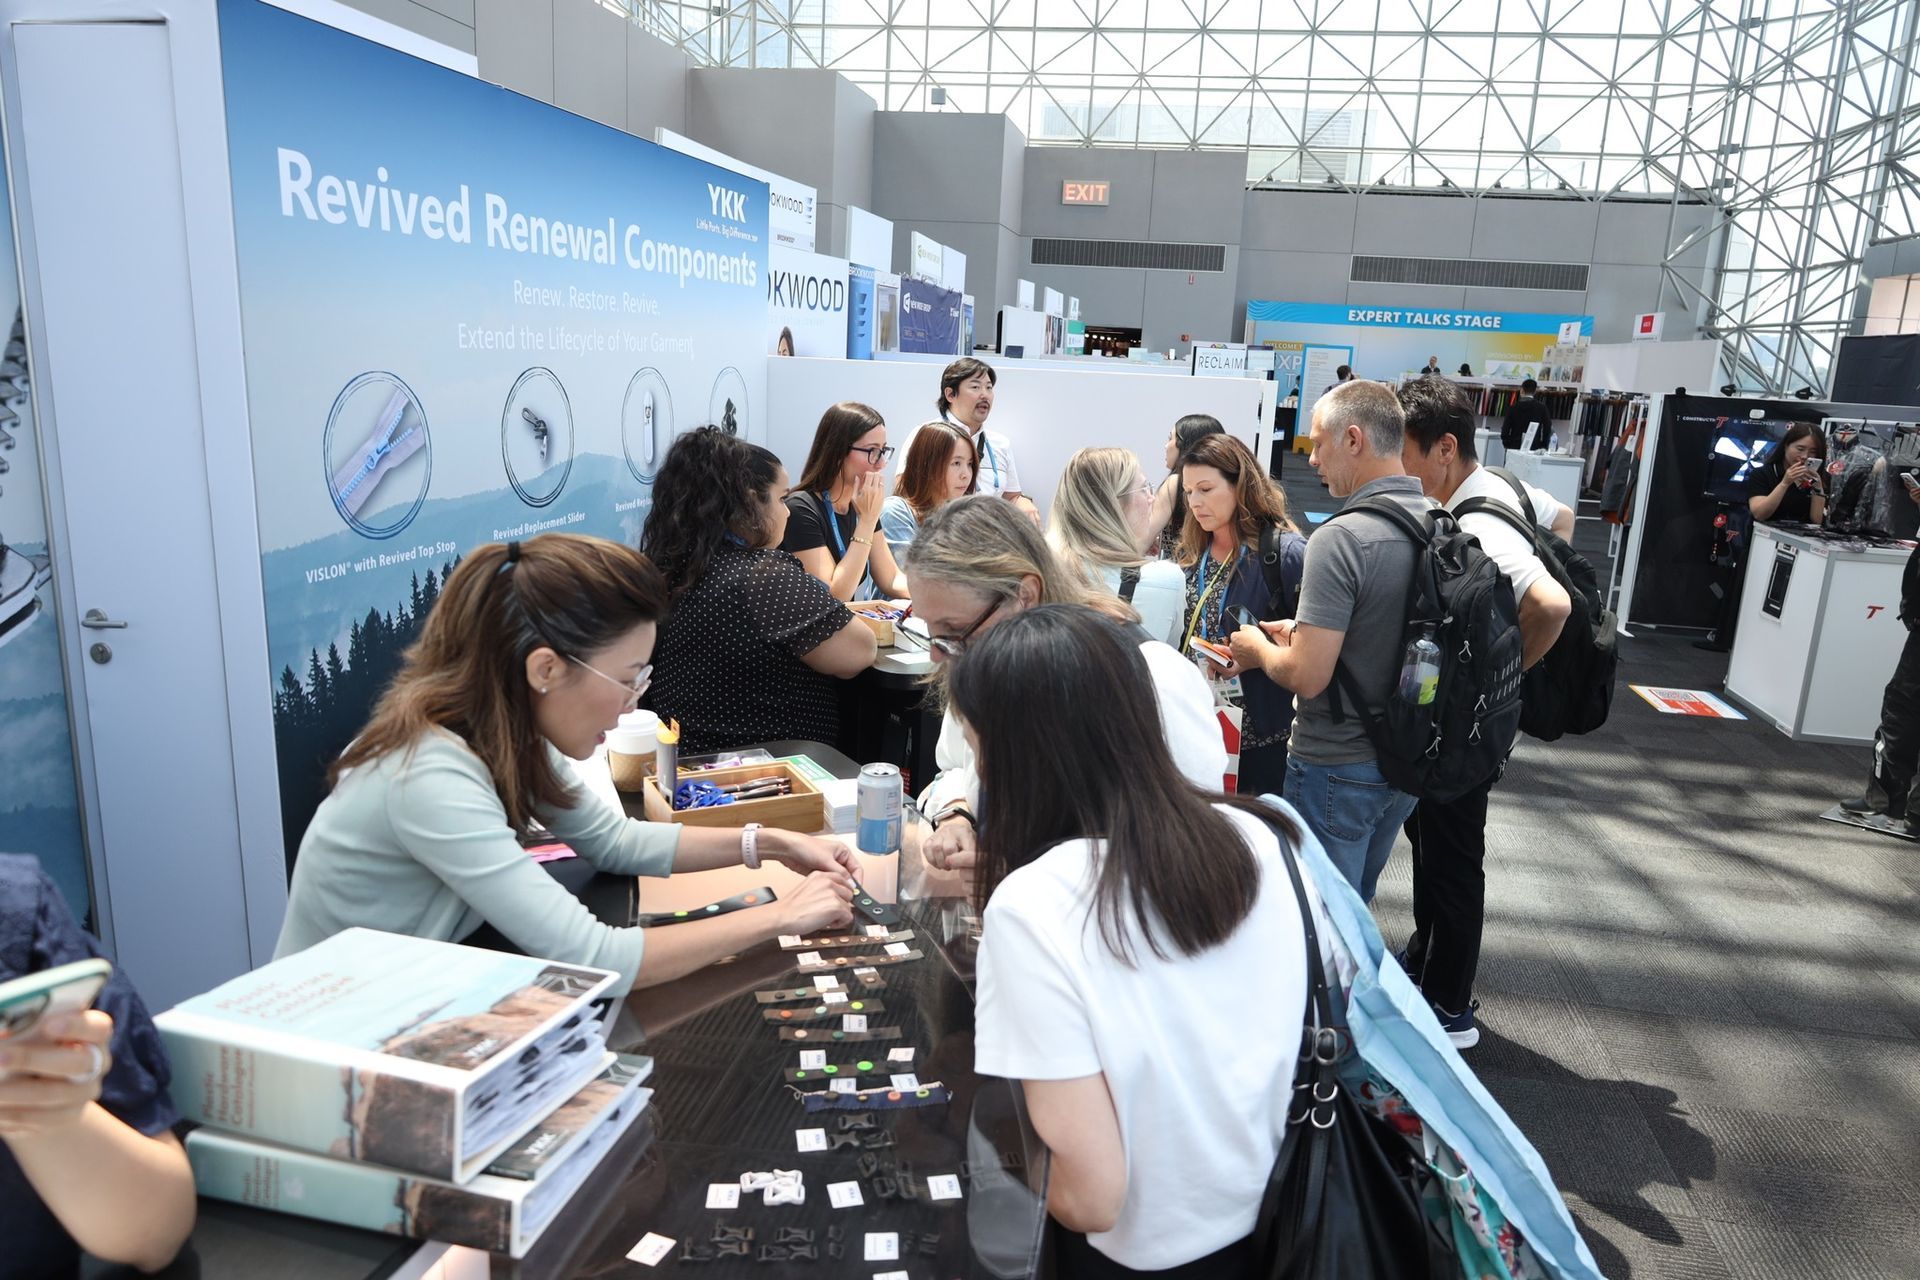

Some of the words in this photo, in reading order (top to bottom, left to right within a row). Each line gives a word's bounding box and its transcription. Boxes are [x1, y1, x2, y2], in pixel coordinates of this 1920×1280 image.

[707, 183, 746, 224] YKK
[1065, 183, 1107, 201] EXIT
[277, 147, 471, 244] Revived
[485, 193, 616, 266] Renewal
[624, 225, 757, 288] Components
[514, 280, 566, 307] Renew.
[569, 286, 619, 312] Restore.
[623, 292, 661, 316] Revive.
[1348, 309, 1402, 324] EXPERT
[1405, 311, 1451, 326] TALKS
[1454, 314, 1502, 328] STAGE
[458, 323, 516, 350] Extend
[520, 325, 544, 350] the
[548, 327, 604, 357] Lifecycle
[607, 329, 621, 351] of
[622, 332, 648, 353] Your
[1198, 355, 1243, 369] RECLAIM
[615, 498, 637, 512] Revived
[493, 524, 524, 541] Revived
[524, 515, 567, 534] Replacement
[567, 511, 586, 524] Slider
[354, 556, 377, 573] with
[379, 547, 417, 567] Revived
[418, 544, 434, 559] Top
[436, 541, 456, 554] Stop
